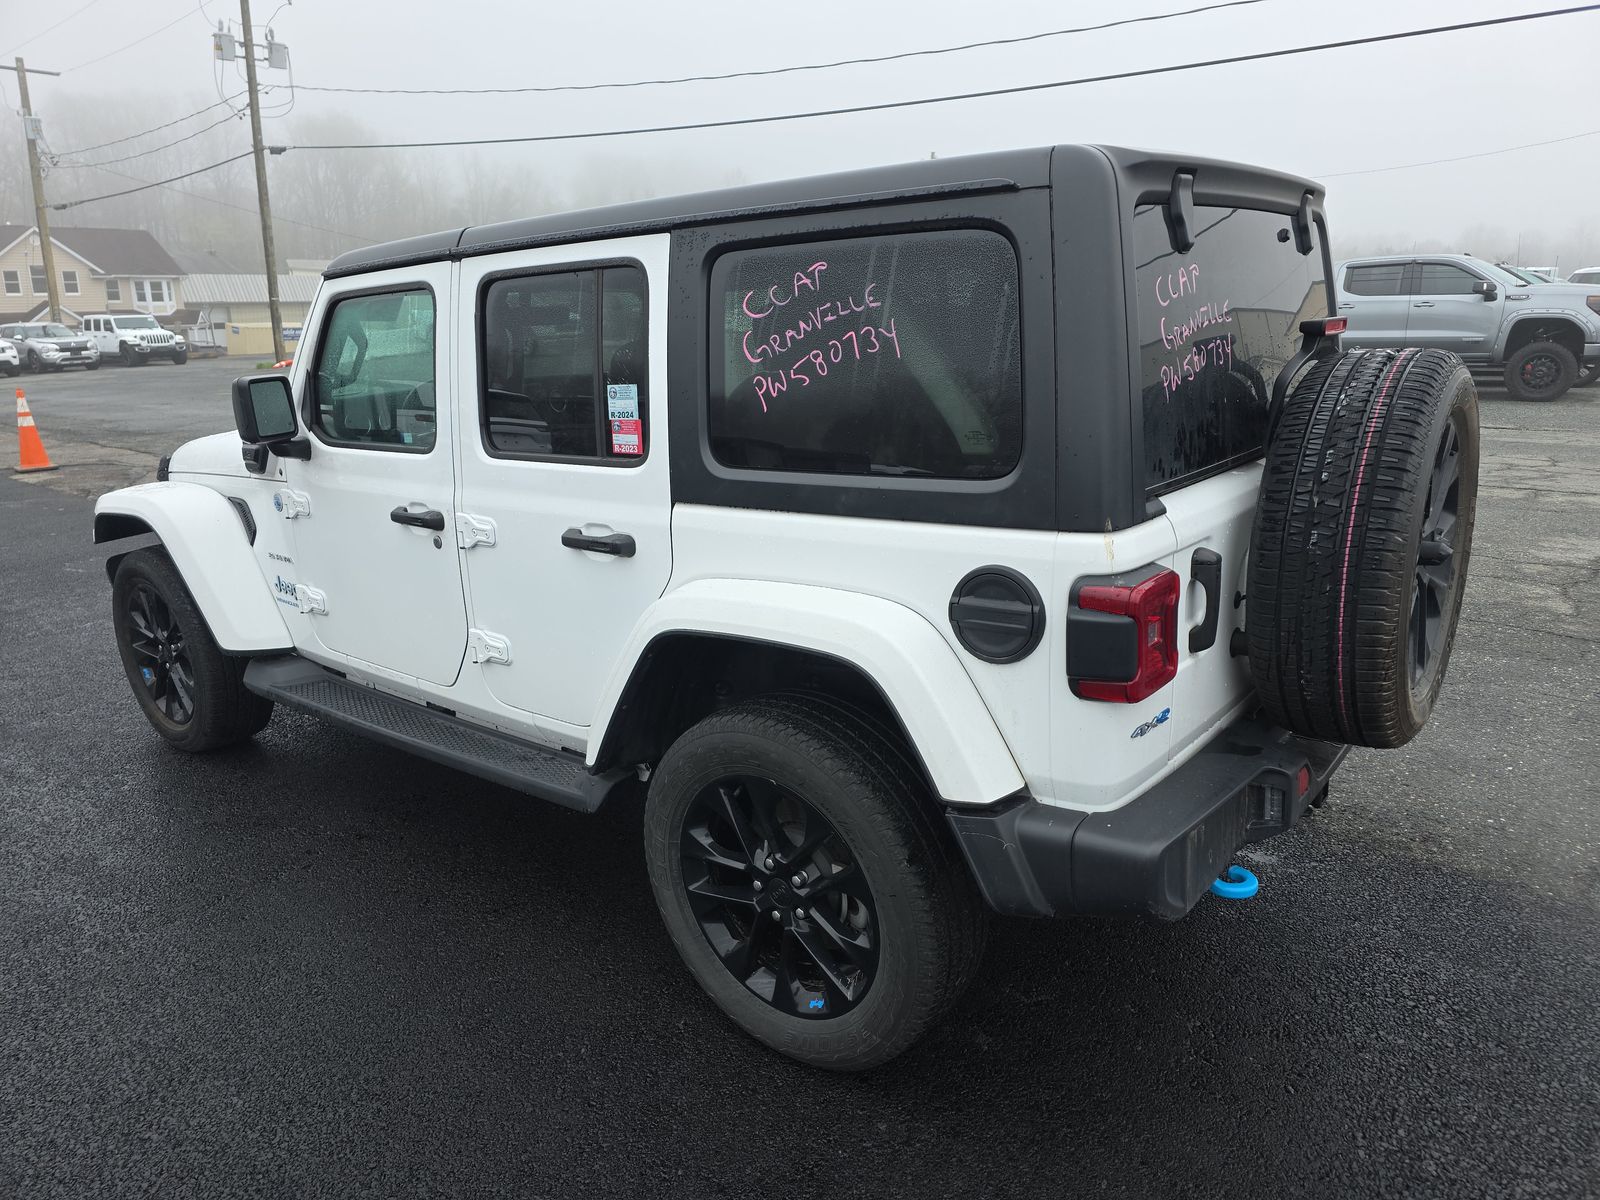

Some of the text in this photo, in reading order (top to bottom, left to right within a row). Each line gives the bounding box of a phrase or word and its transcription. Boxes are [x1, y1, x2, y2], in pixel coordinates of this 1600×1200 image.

[743, 283, 881, 363] GRANVILLE
[1160, 300, 1232, 350] GRANVILLE
[753, 318, 900, 413] PW580734
[1160, 332, 1232, 403] PW580734
[614, 444, 638, 452] R-2023
